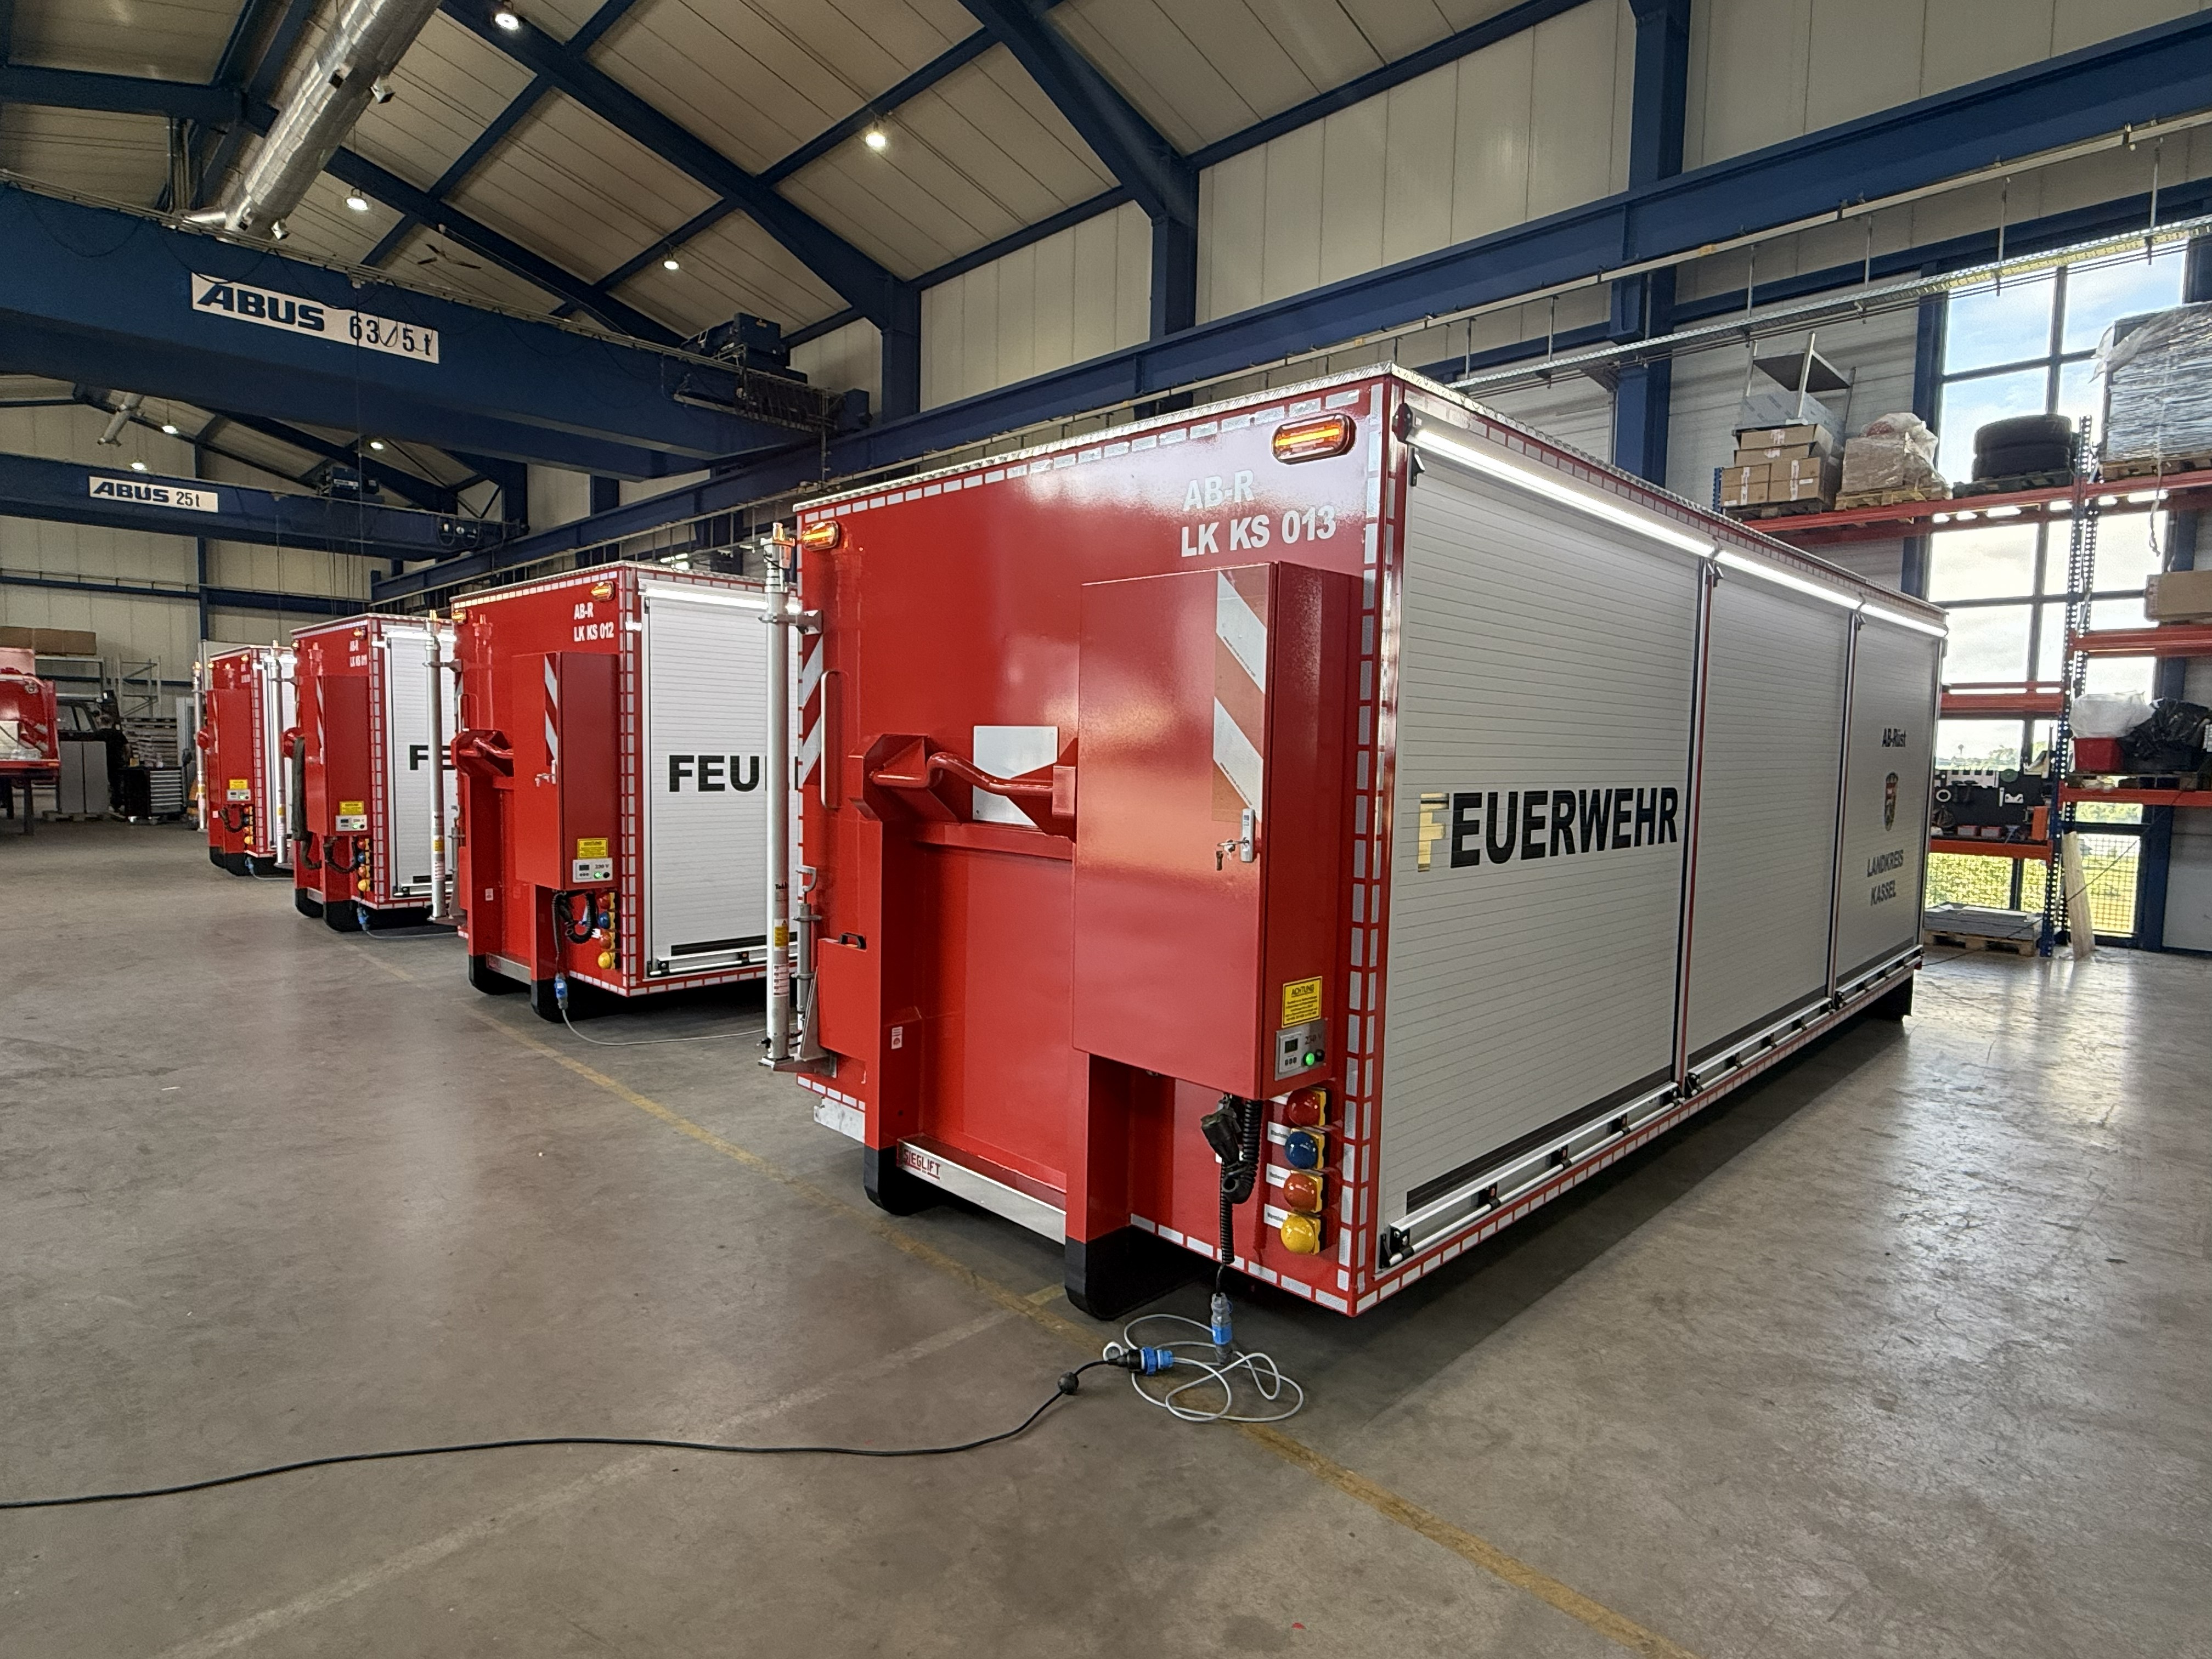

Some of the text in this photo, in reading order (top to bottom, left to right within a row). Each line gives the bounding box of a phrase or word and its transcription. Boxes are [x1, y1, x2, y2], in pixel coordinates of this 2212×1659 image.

[197, 283, 325, 331] ABUS
[93, 482, 170, 503] ABUS
[1183, 470, 1255, 511] AB-R
[1181, 505, 1336, 557] LK KS 013
[574, 601, 594, 620] AB-R
[574, 621, 614, 642] LK KS 012
[669, 755, 798, 792] FEU
[1418, 787, 1678, 872] FEUERWEHR
[1867, 849, 1904, 878] LANDKREIS
[1870, 879, 1896, 906] KASSEL
[904, 1149, 941, 1176] SIEGLIFT
